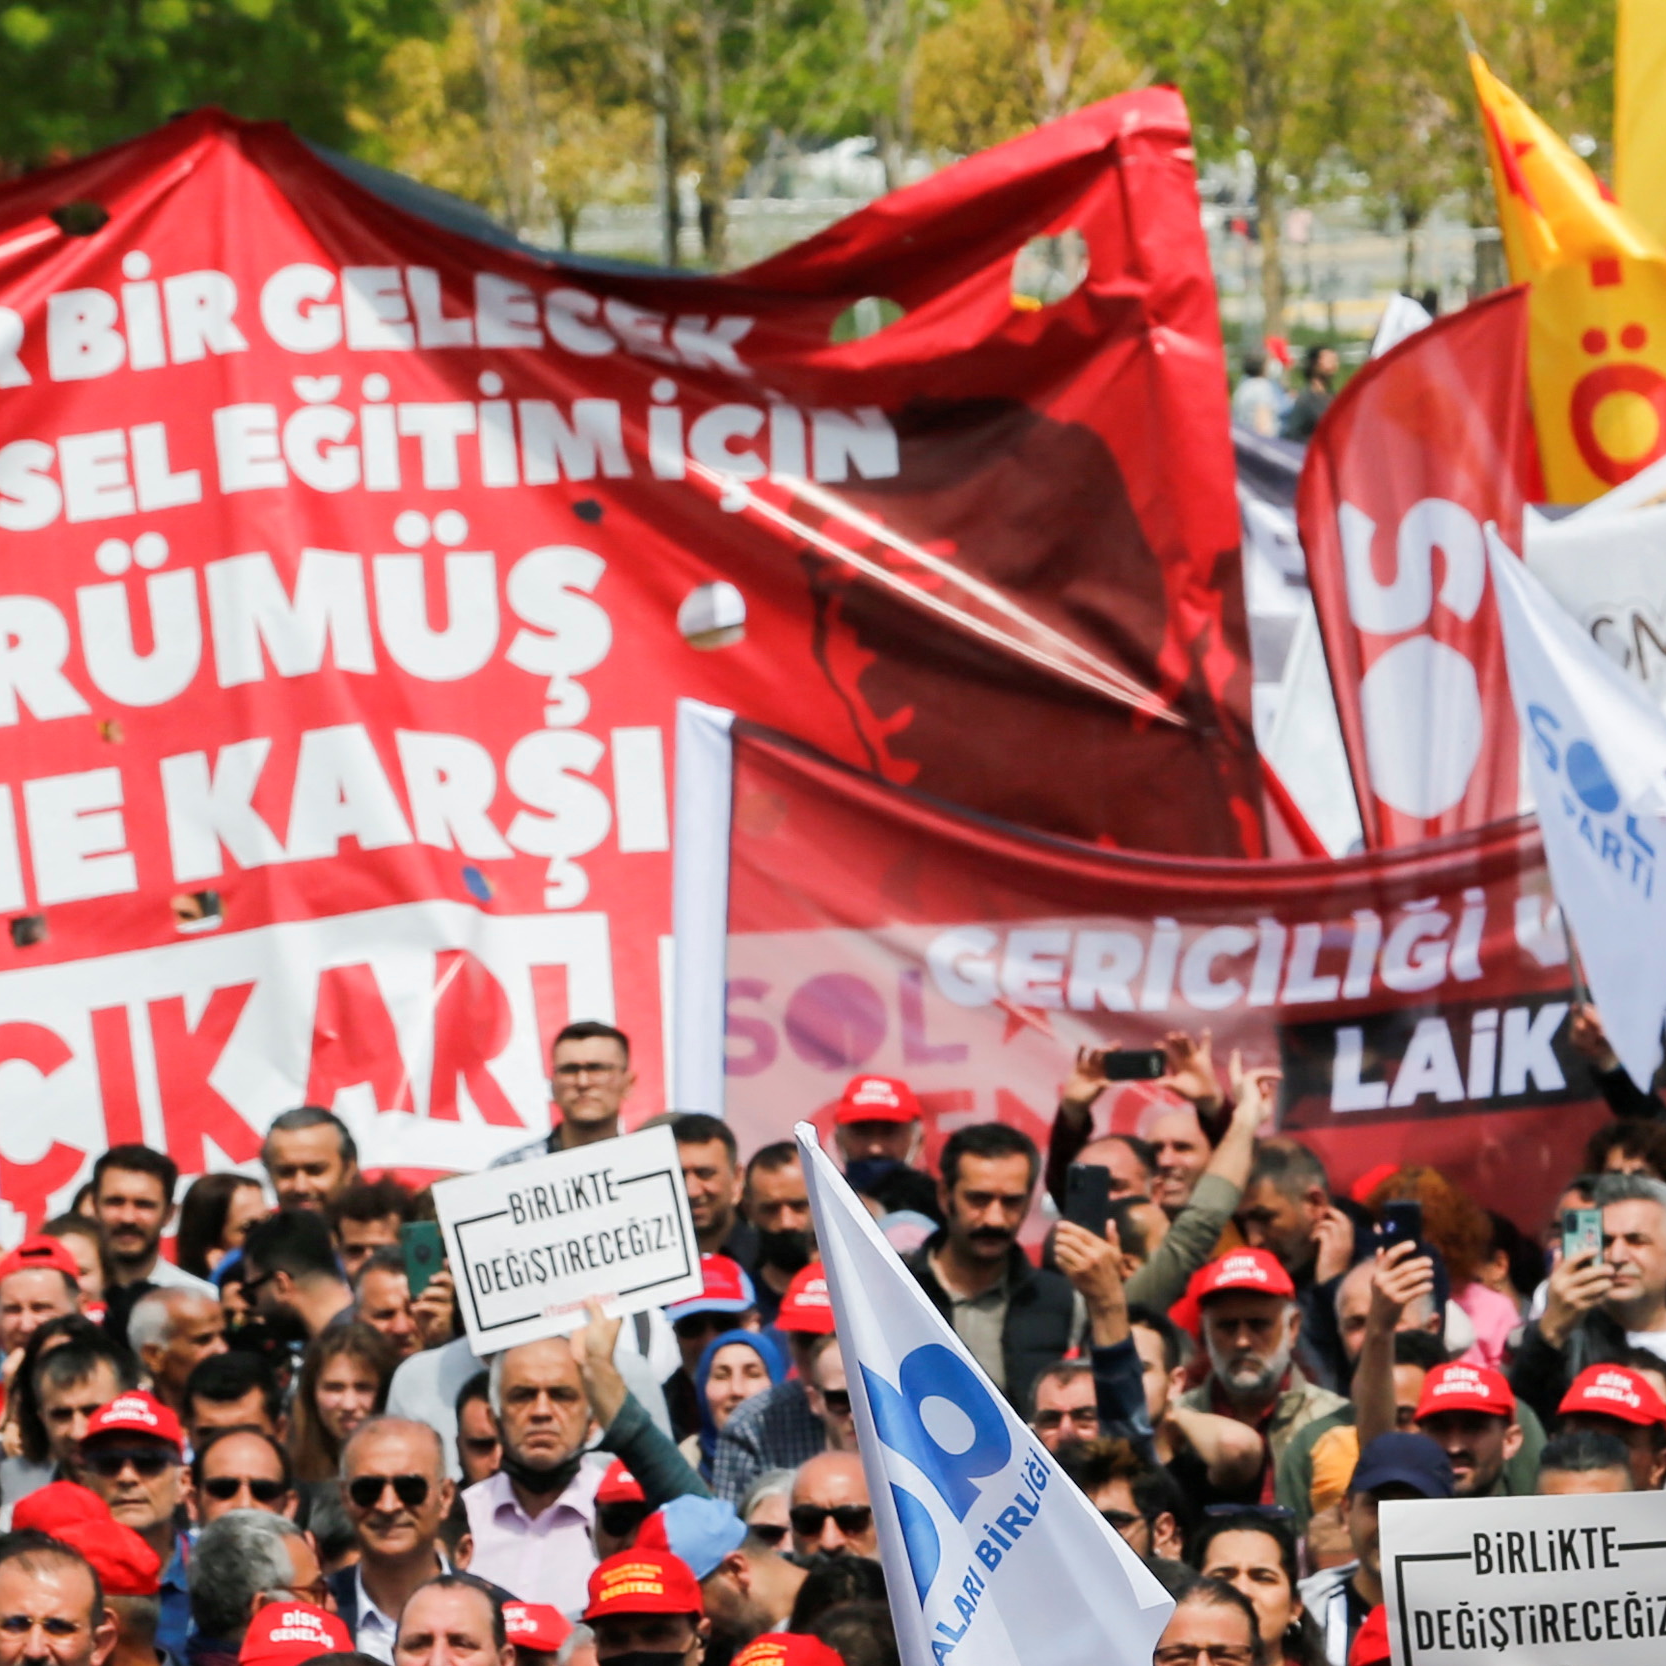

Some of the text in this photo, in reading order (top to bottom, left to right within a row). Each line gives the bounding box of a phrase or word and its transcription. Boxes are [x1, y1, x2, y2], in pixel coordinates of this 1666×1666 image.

[47, 251, 249, 383] BİR
[260, 263, 755, 376] GELECEK
[213, 371, 633, 494] EĞİTİM
[648, 378, 900, 513] İÇİN
[161, 724, 669, 911] KARŞI
[926, 884, 1487, 1012] GERİCİLİĞİ
[1331, 1002, 1571, 1113] LAİK
[508, 1168, 619, 1223] BİRLİKTE
[474, 1212, 677, 1296] DEĞİŞTİRECEĞİZ!
[975, 1447, 1051, 1572] BİRLİĞİ
[1473, 1527, 1620, 1576] BİRLİKTE
[269, 1626, 334, 1650] GENEL-İŞ
[282, 1609, 322, 1630] DİSK
